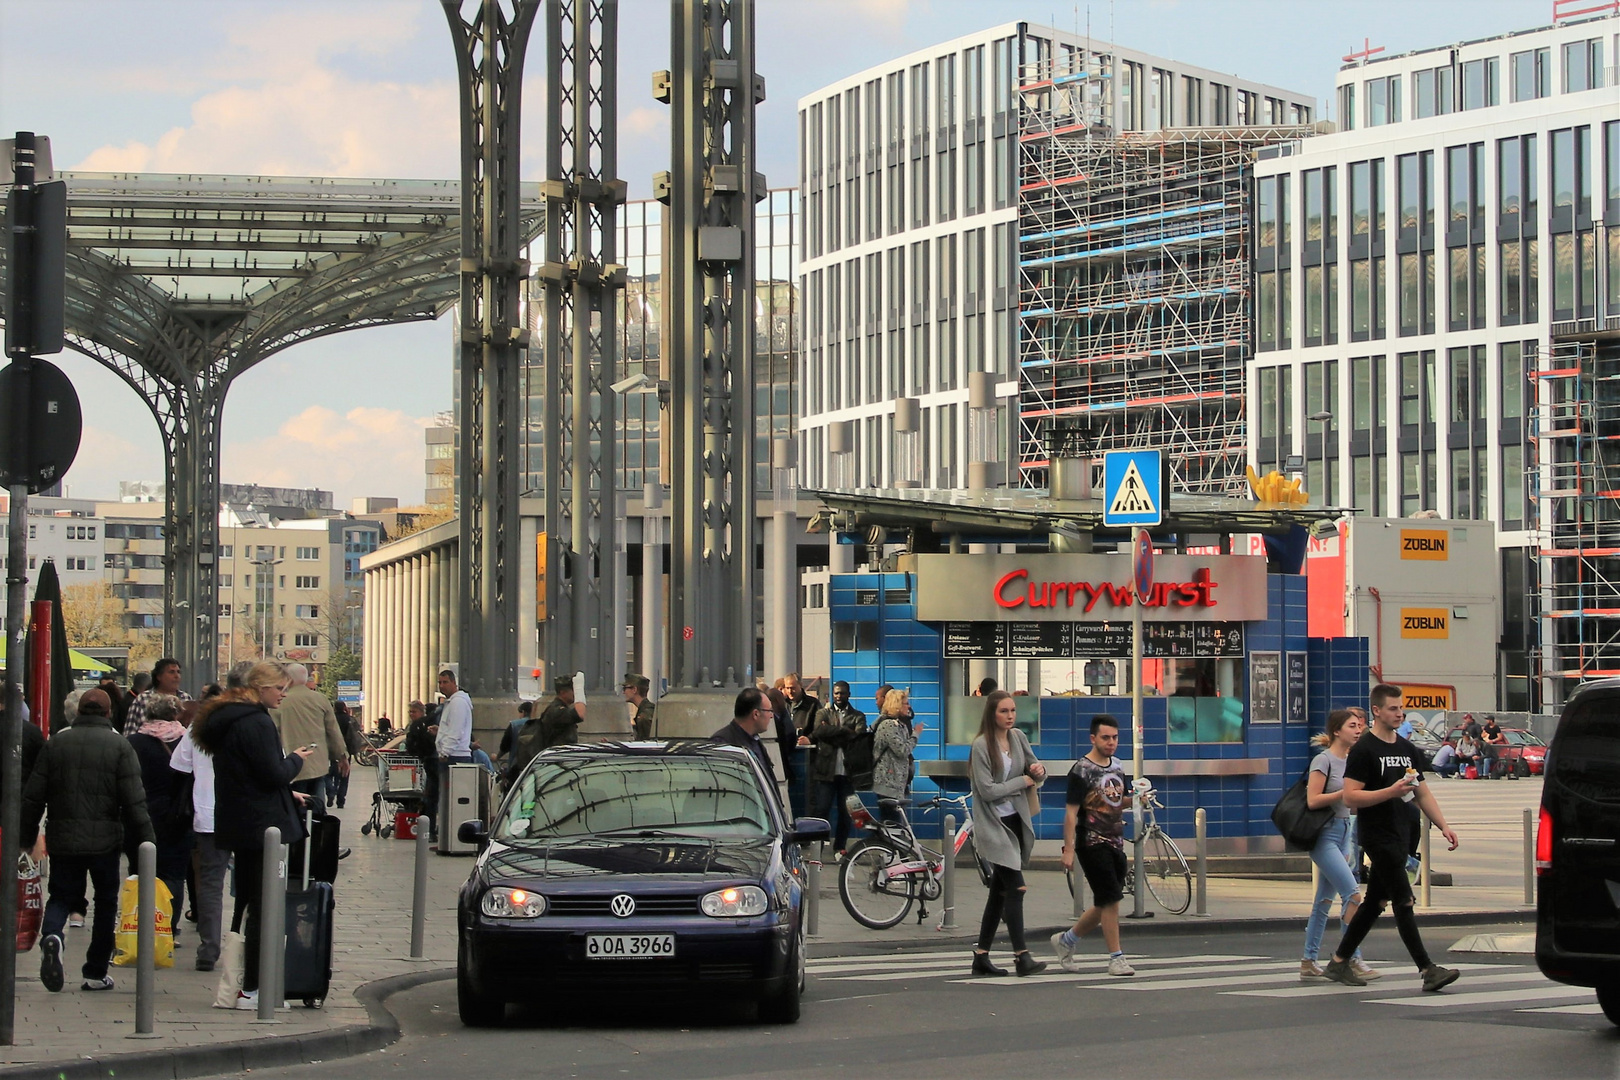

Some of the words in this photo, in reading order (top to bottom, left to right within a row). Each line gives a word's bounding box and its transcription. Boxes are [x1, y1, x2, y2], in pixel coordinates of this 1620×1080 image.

[1404, 538, 1445, 552] ZÜBLIN
[993, 568, 1218, 613] Currywurst
[1404, 617, 1445, 630] ZÜBLIN
[1405, 696, 1446, 708] ZÜBLIN
[1379, 756, 1412, 776] YEEZUS
[629, 937, 672, 954] 3966
